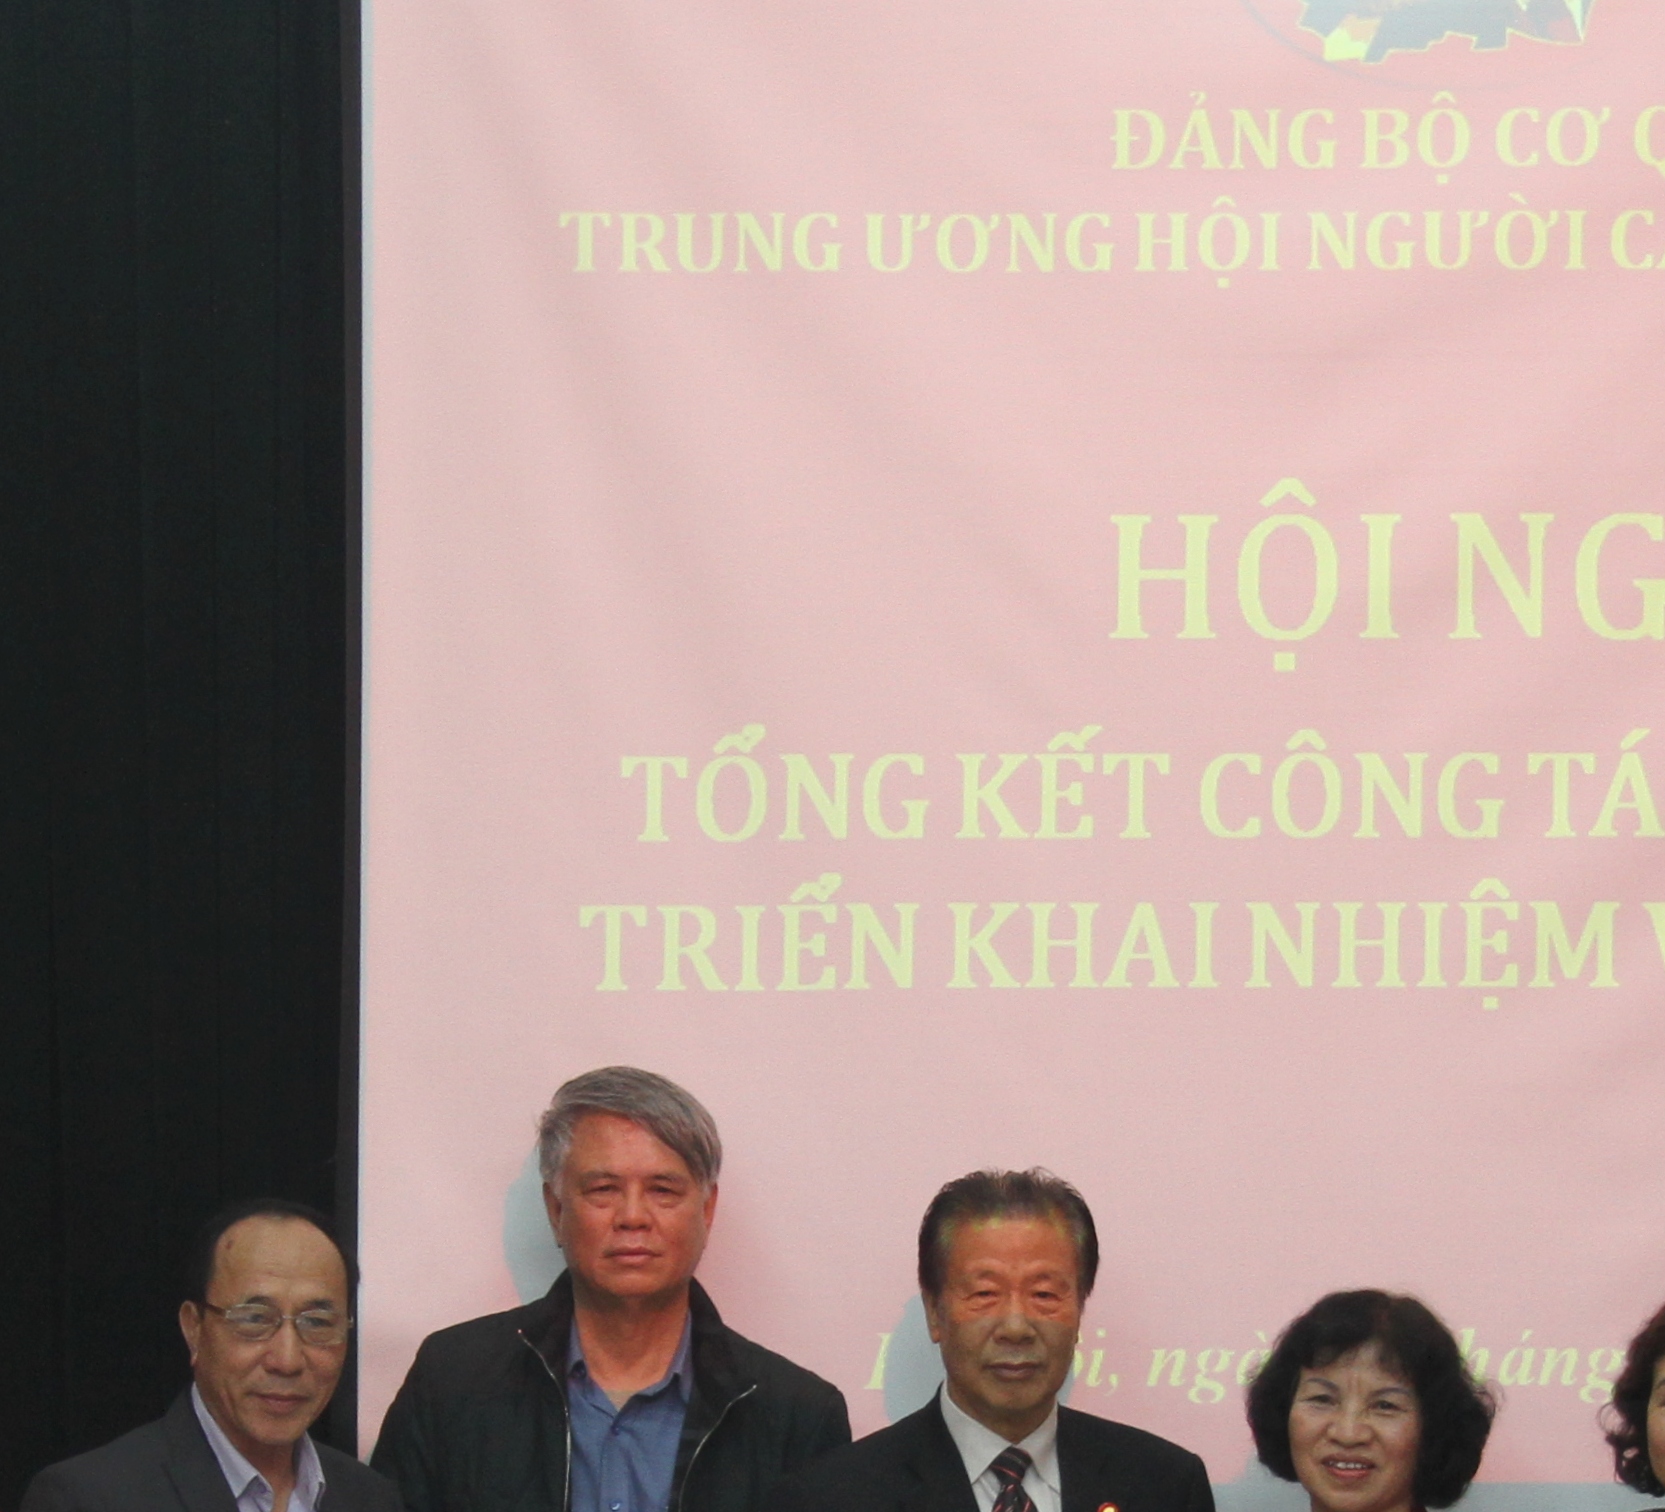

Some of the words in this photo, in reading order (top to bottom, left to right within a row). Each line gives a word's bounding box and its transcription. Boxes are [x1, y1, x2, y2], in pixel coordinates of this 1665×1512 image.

[1110, 92, 1337, 168] ĐẢNG
[1361, 90, 1472, 183] BỘ
[1495, 103, 1611, 167] CƠ
[558, 212, 841, 272] TRUNG
[866, 212, 1113, 272] ƯƠNG
[1136, 195, 1280, 288] HỘI
[1307, 192, 1587, 270] NGƯỜI
[1108, 476, 1403, 672] HỘI
[619, 722, 929, 842] TỔNG
[956, 722, 1172, 840] KẾT
[1197, 727, 1505, 842] CÔNG
[578, 872, 920, 992] TRIỂN
[946, 900, 1220, 990] KHAI
[1245, 876, 1622, 1010] NHIỆM
[1147, 1330, 1274, 1404] ngà
[1458, 1328, 1627, 1403] háng
